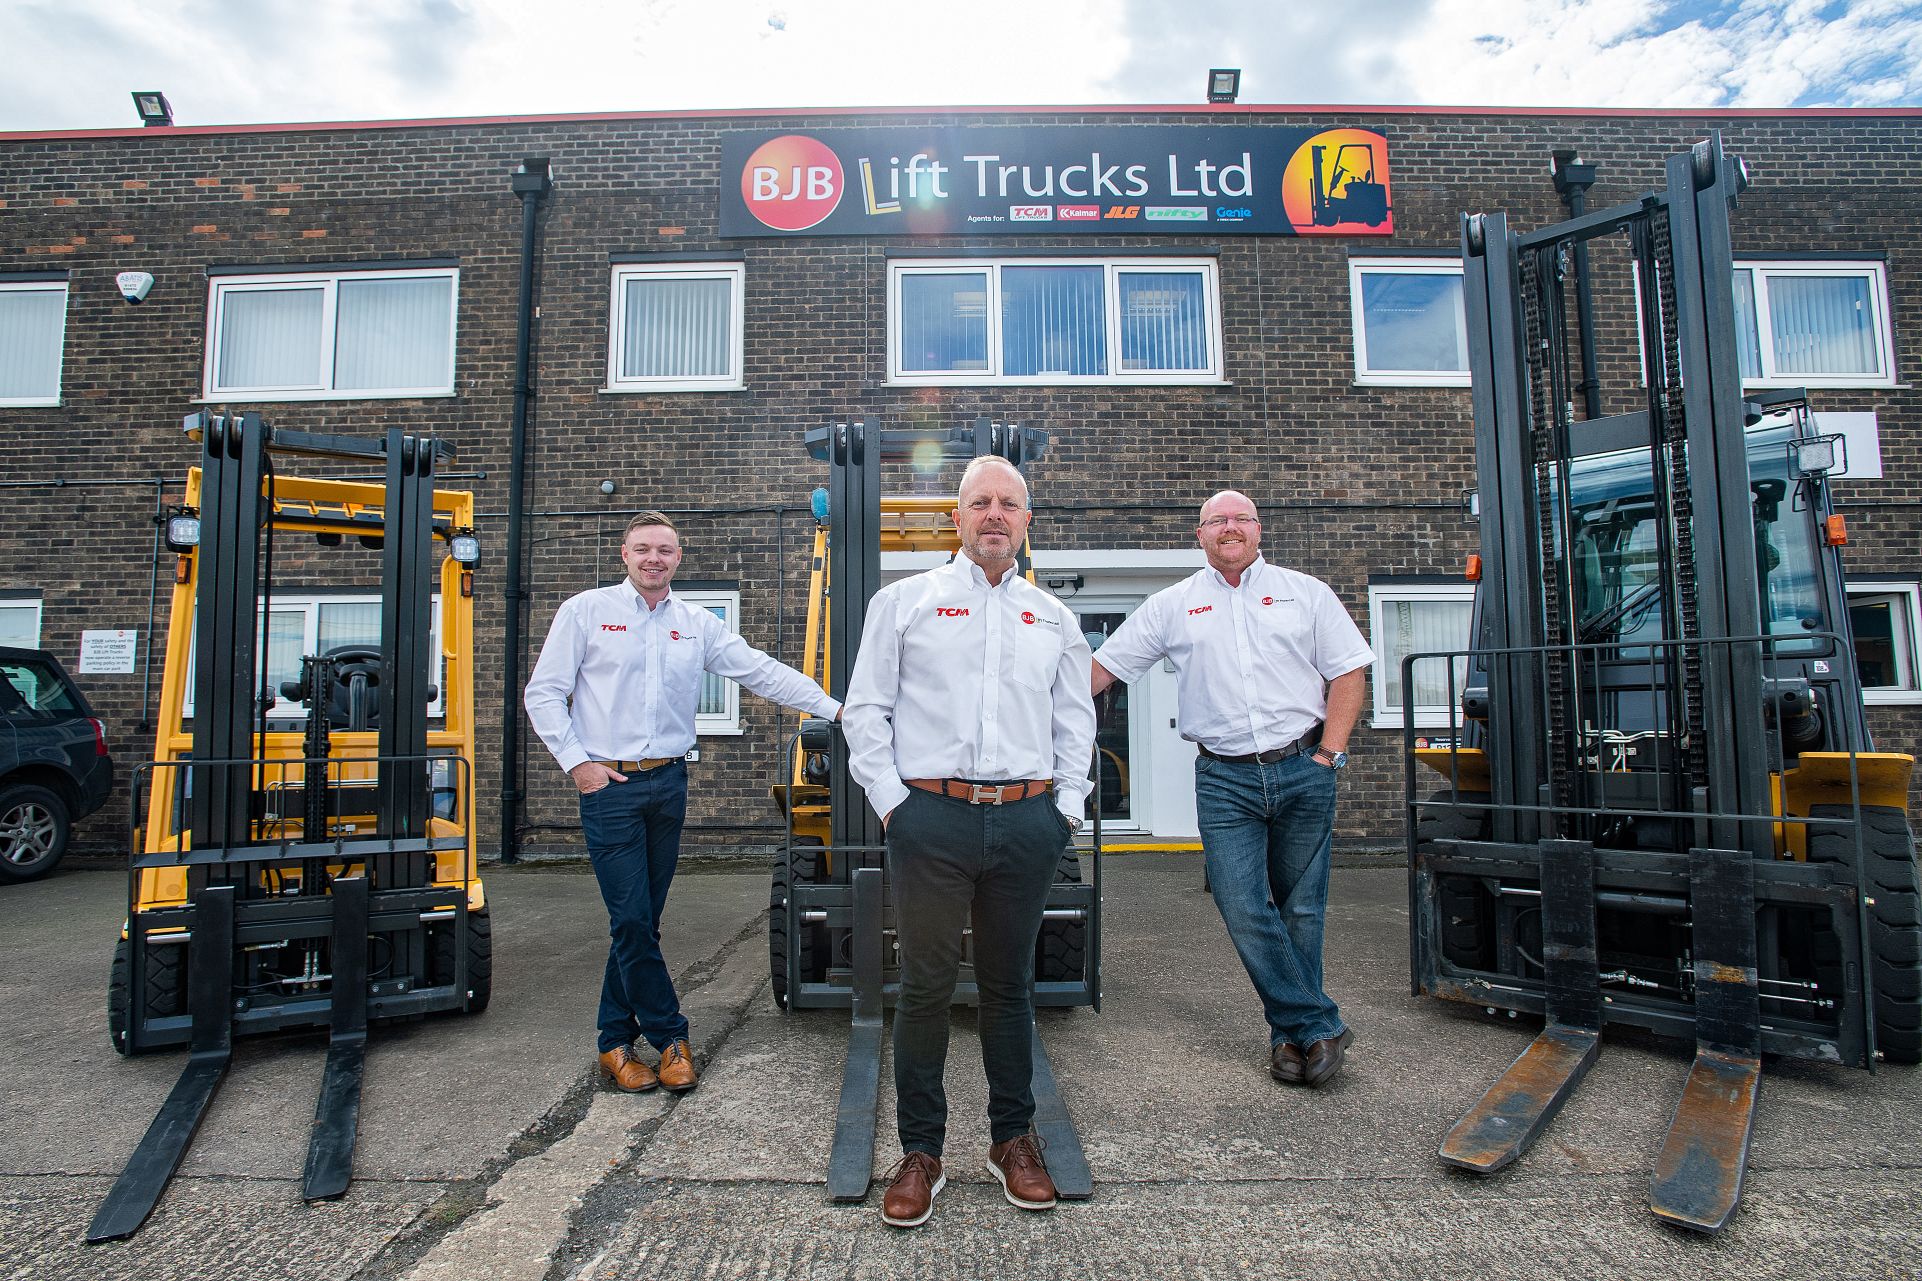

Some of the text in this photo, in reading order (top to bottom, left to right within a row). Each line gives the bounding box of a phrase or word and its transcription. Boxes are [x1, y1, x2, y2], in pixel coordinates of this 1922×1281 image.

[752, 152, 1253, 215] BJB Lift Trucks Ltd
[1014, 207, 1048, 216] TCM
[1069, 209, 1097, 217] Kalmar
[1103, 205, 1141, 219] JLG
[1147, 207, 1204, 219] nifty
[1215, 206, 1253, 218] Genie
[967, 215, 992, 223] Agents
[936, 607, 970, 617] TCM
[1187, 605, 1213, 616] TCM
[1022, 614, 1035, 622] BJB
[601, 624, 627, 632] TCM
